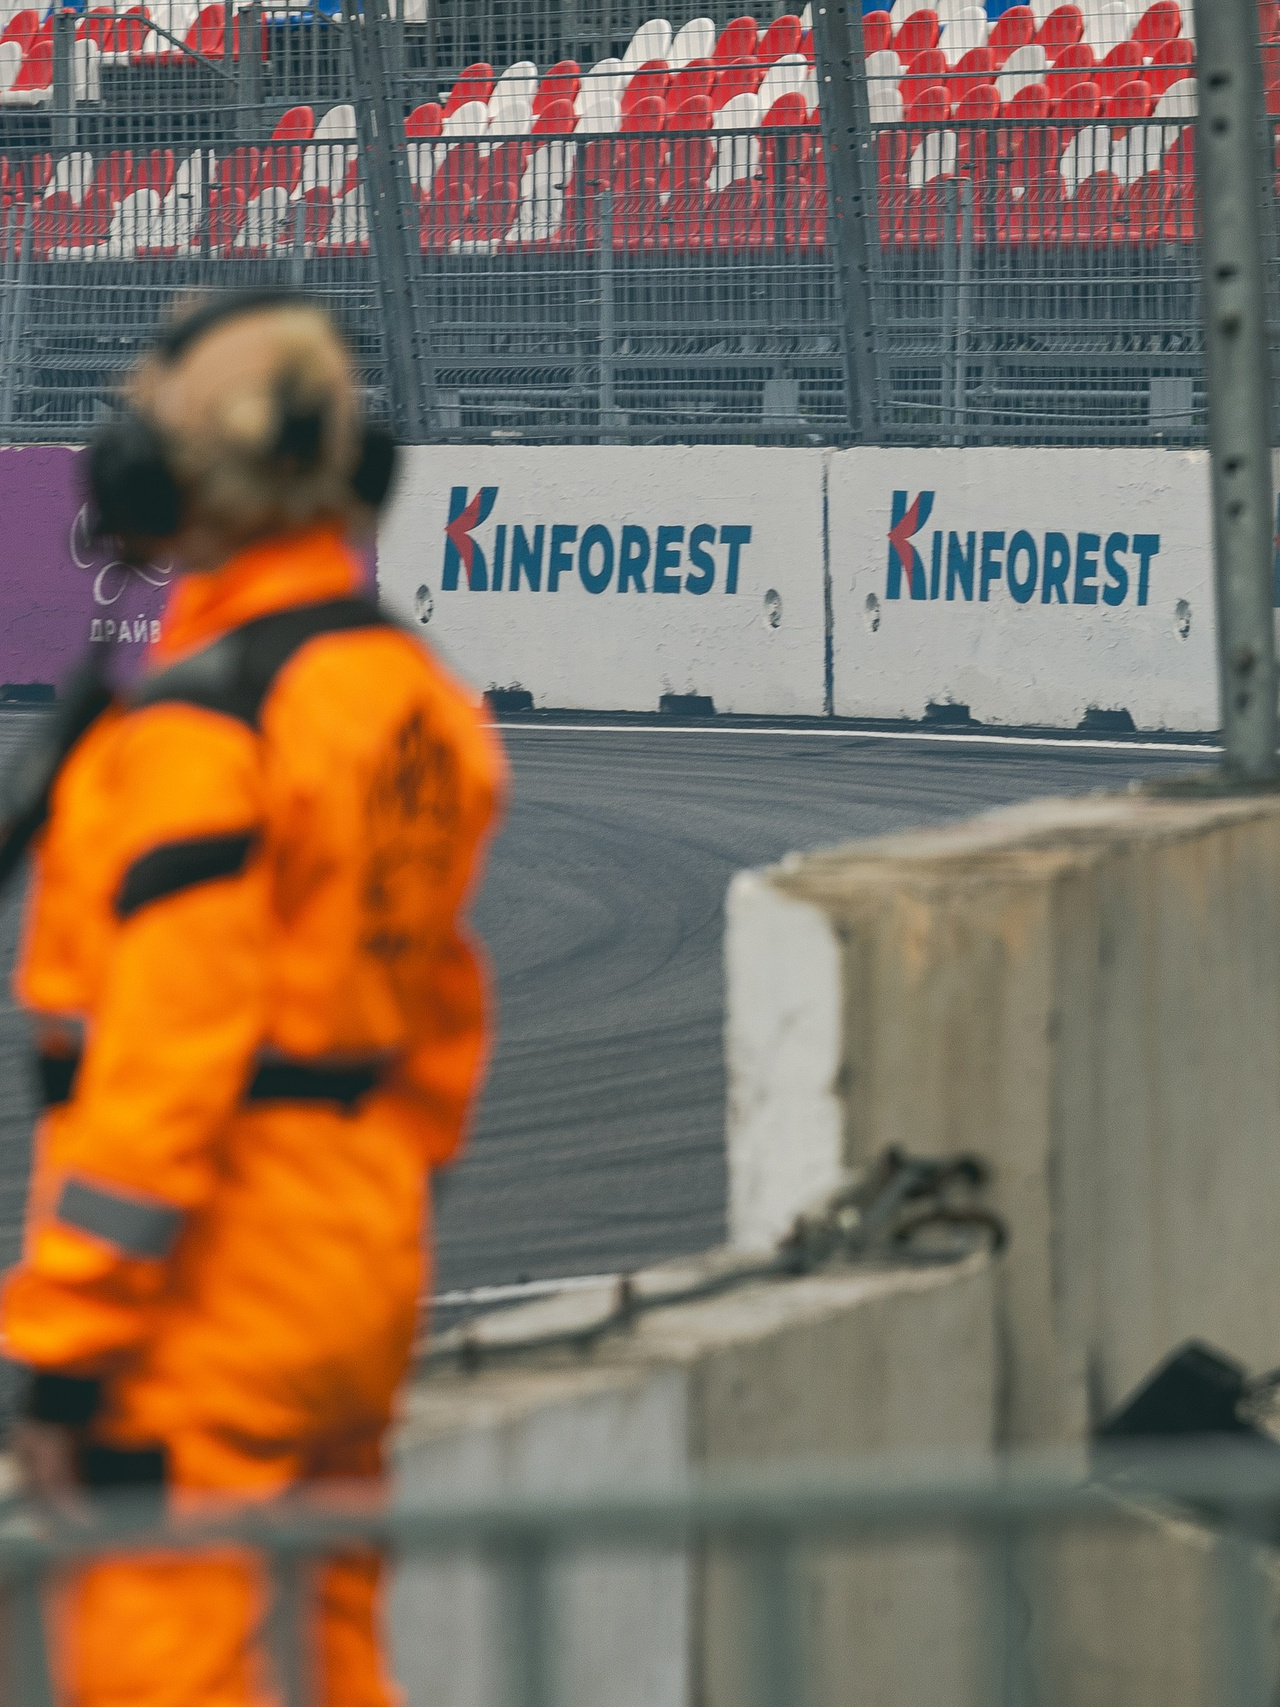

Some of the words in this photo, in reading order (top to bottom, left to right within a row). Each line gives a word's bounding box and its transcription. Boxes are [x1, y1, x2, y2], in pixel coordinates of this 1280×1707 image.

[441, 486, 753, 595] KINFOREST
[885, 490, 1161, 606] KINFOREST
[88, 613, 161, 645] ДРАЙВ
